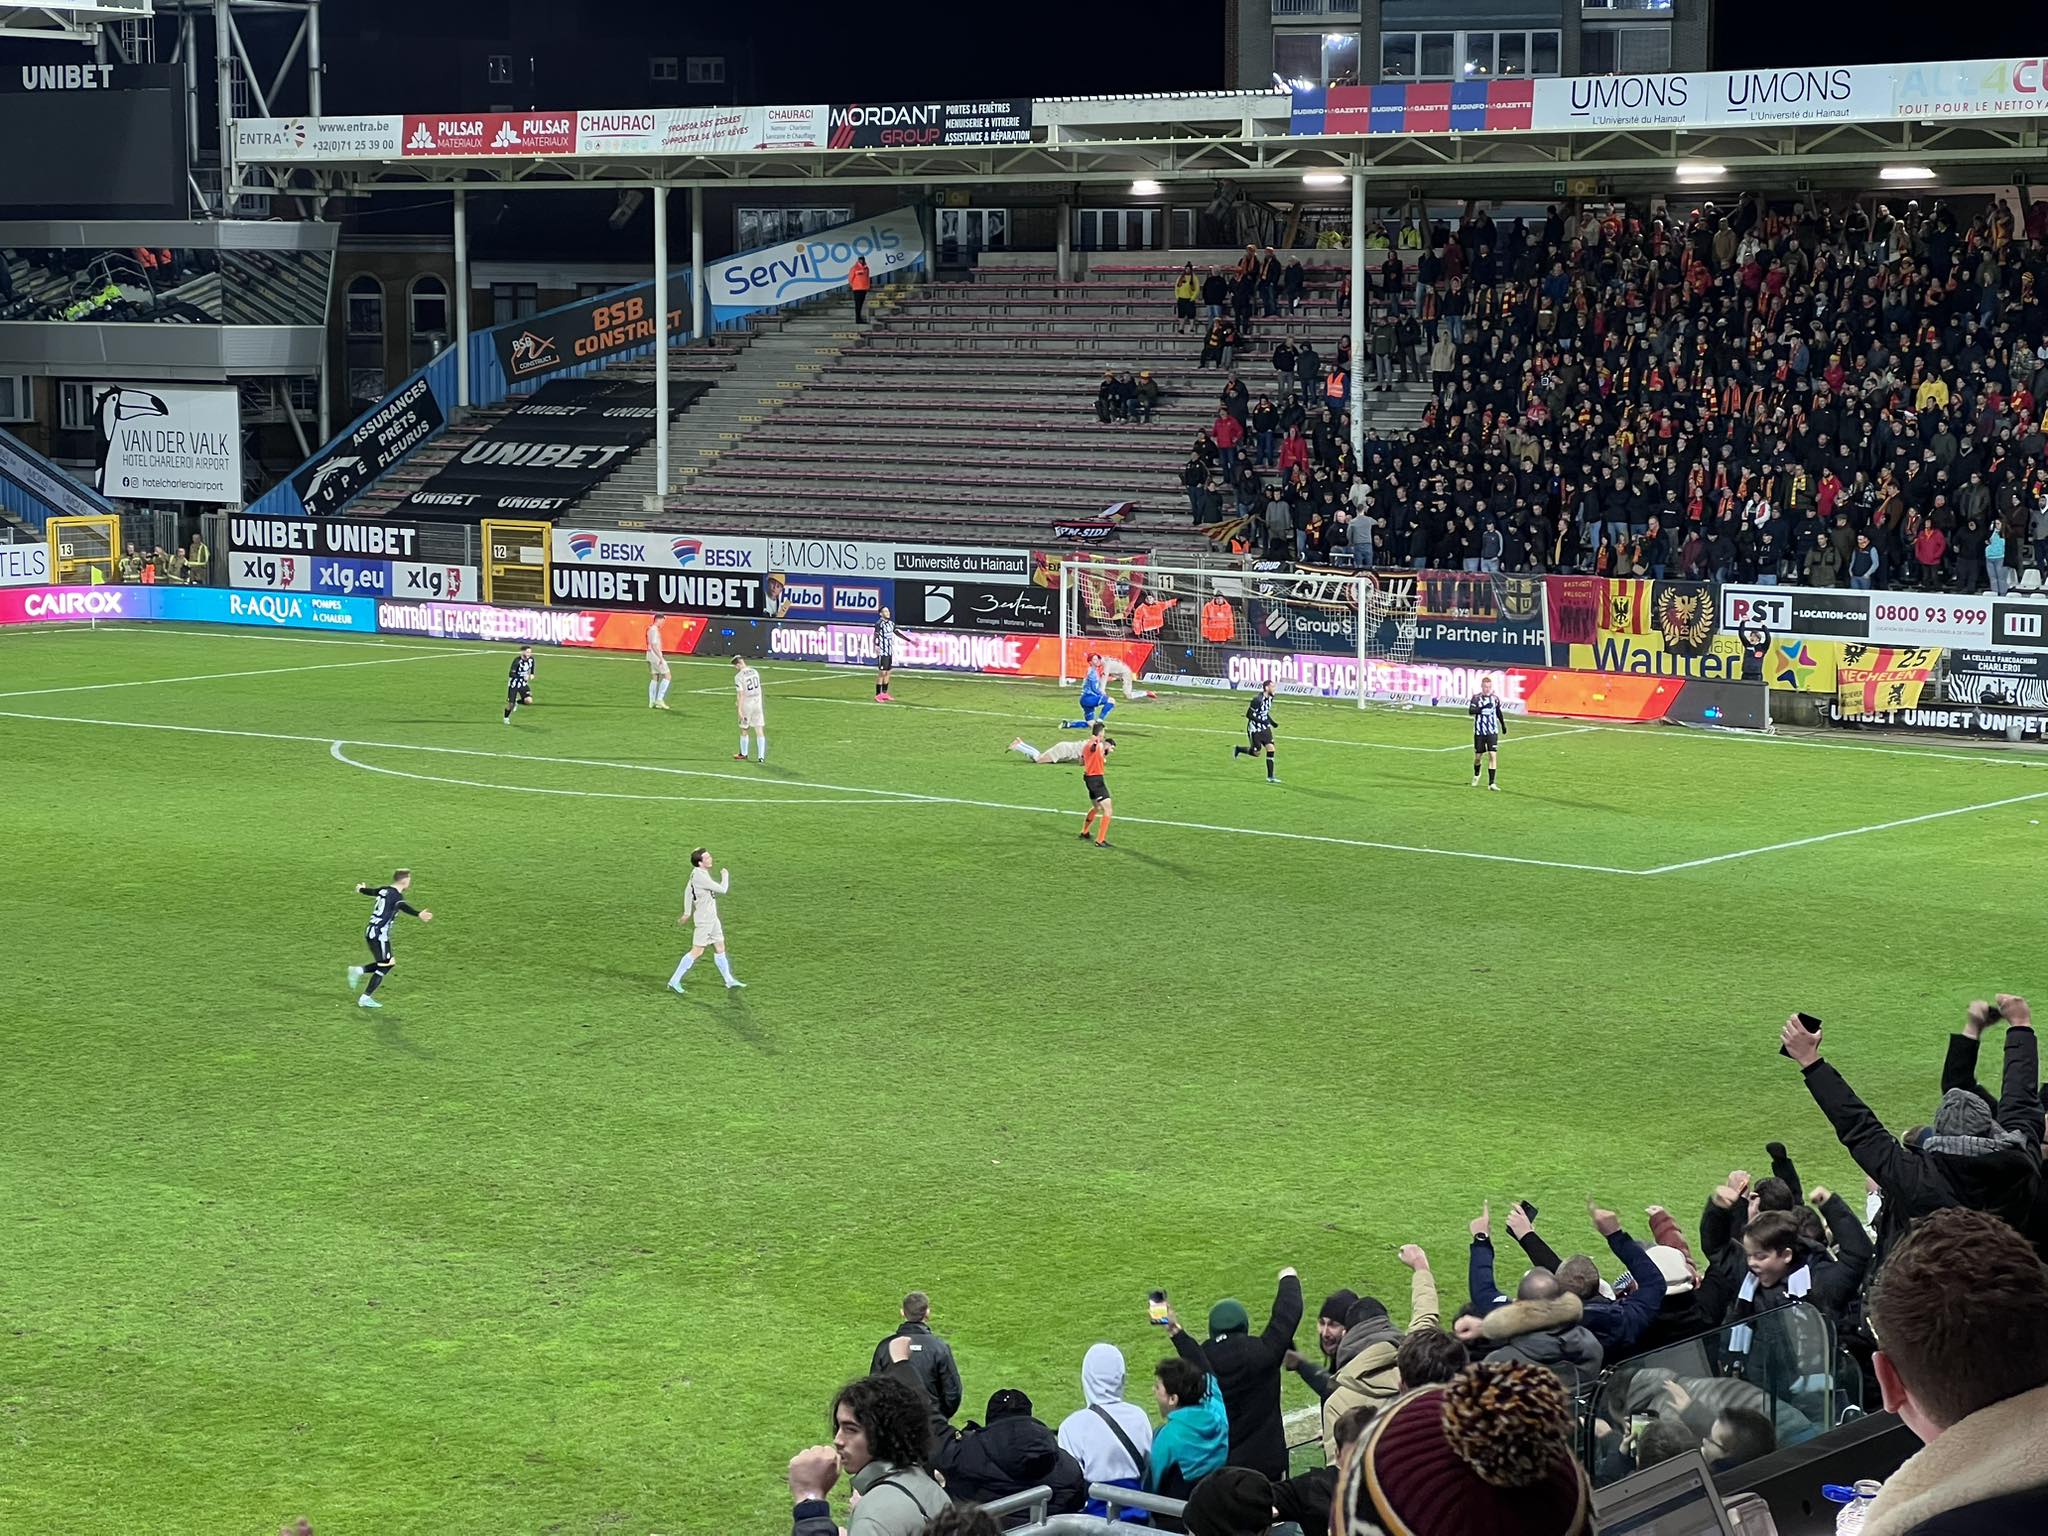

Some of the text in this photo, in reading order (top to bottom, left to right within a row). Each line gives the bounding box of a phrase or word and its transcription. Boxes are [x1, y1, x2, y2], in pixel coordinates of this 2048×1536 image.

[21, 64, 113, 90] UNIBET
[1570, 77, 1687, 112] UMONS
[1728, 69, 1851, 108] UMONS
[768, 109, 813, 120] CHAURACI
[830, 105, 941, 127] MORDANT
[945, 104, 970, 115] PORTES
[978, 101, 1010, 114] FENÊTRES
[1751, 108, 1849, 120] L'Université du Hainaut
[1899, 103, 1929, 114] TOUT
[1935, 102, 1968, 113] POUR
[1975, 101, 1988, 111] LE
[318, 121, 389, 132] www.entra.be
[438, 121, 483, 136] PULSAR
[523, 119, 569, 134] PULSAR
[580, 114, 655, 132] CHAURACI
[668, 122, 699, 133] SPONSOR
[700, 119, 714, 128] DES
[945, 117, 983, 129] MENUISERIE
[991, 116, 1020, 127] VITRERIE
[1592, 114, 1686, 125] L'Université du Hainaut
[240, 133, 281, 145] ENTRA
[661, 135, 699, 146] SUPPORTER
[701, 132, 710, 141] DE
[711, 130, 725, 140] VOS
[880, 128, 941, 145] GROUP
[944, 131, 983, 143] ASSISTANCE
[990, 128, 1030, 141] RÉPARATION
[312, 139, 394, 152] +32(0)71 25 39 00
[592, 297, 644, 331] BSB
[512, 337, 532, 352] BSB
[519, 355, 552, 370] CONSTRUCT
[352, 380, 427, 447] ASSURANCES
[516, 405, 587, 417] UNIBET
[377, 410, 417, 446] PRÊTS
[121, 429, 229, 456] VAN DER VALK
[377, 420, 430, 468] FLEURUS
[122, 454, 229, 470] HOTEL CHARLEROI AIRPORT
[460, 441, 629, 469] UNIBET
[142, 477, 223, 491] hotelcharleroiairport
[411, 491, 482, 506] UNIBET
[497, 496, 570, 510] UNIBET
[230, 518, 415, 556] UNIBET UNIBET
[61, 545, 72, 555] 13
[495, 546, 505, 557] 12
[600, 543, 645, 562] BESIX
[705, 549, 752, 568] BESIX
[243, 556, 276, 586] xlg
[897, 554, 1024, 572] L'Université du Hainaut
[319, 562, 384, 593] xlg.eu
[407, 566, 441, 596] xlg
[1159, 576, 1172, 589] 11
[553, 569, 760, 609] UNIBET UNIBET
[780, 587, 822, 606] Hubo
[25, 592, 122, 616] CAIROX
[230, 594, 302, 623] R-AQUA
[312, 599, 342, 610] POMPES
[836, 590, 877, 609] Hubo
[319, 614, 352, 624] CHALEUR
[379, 603, 443, 631] CONTRÔLE
[1733, 599, 1784, 623] RST
[1876, 605, 1986, 625] 0800 93 999
[1296, 617, 1352, 636] Group S
[1395, 622, 1545, 646] Your Partner in HR
[771, 626, 845, 656] CONTRÔLE
[1897, 649, 1931, 668] 25
[1978, 662, 2021, 673] CHARLEROI
[1229, 655, 1314, 687] CONTRÔLE
[746, 676, 759, 691] 20
[1284, 686, 1315, 694] UNIBET
[1905, 708, 1973, 729] UNIBET
